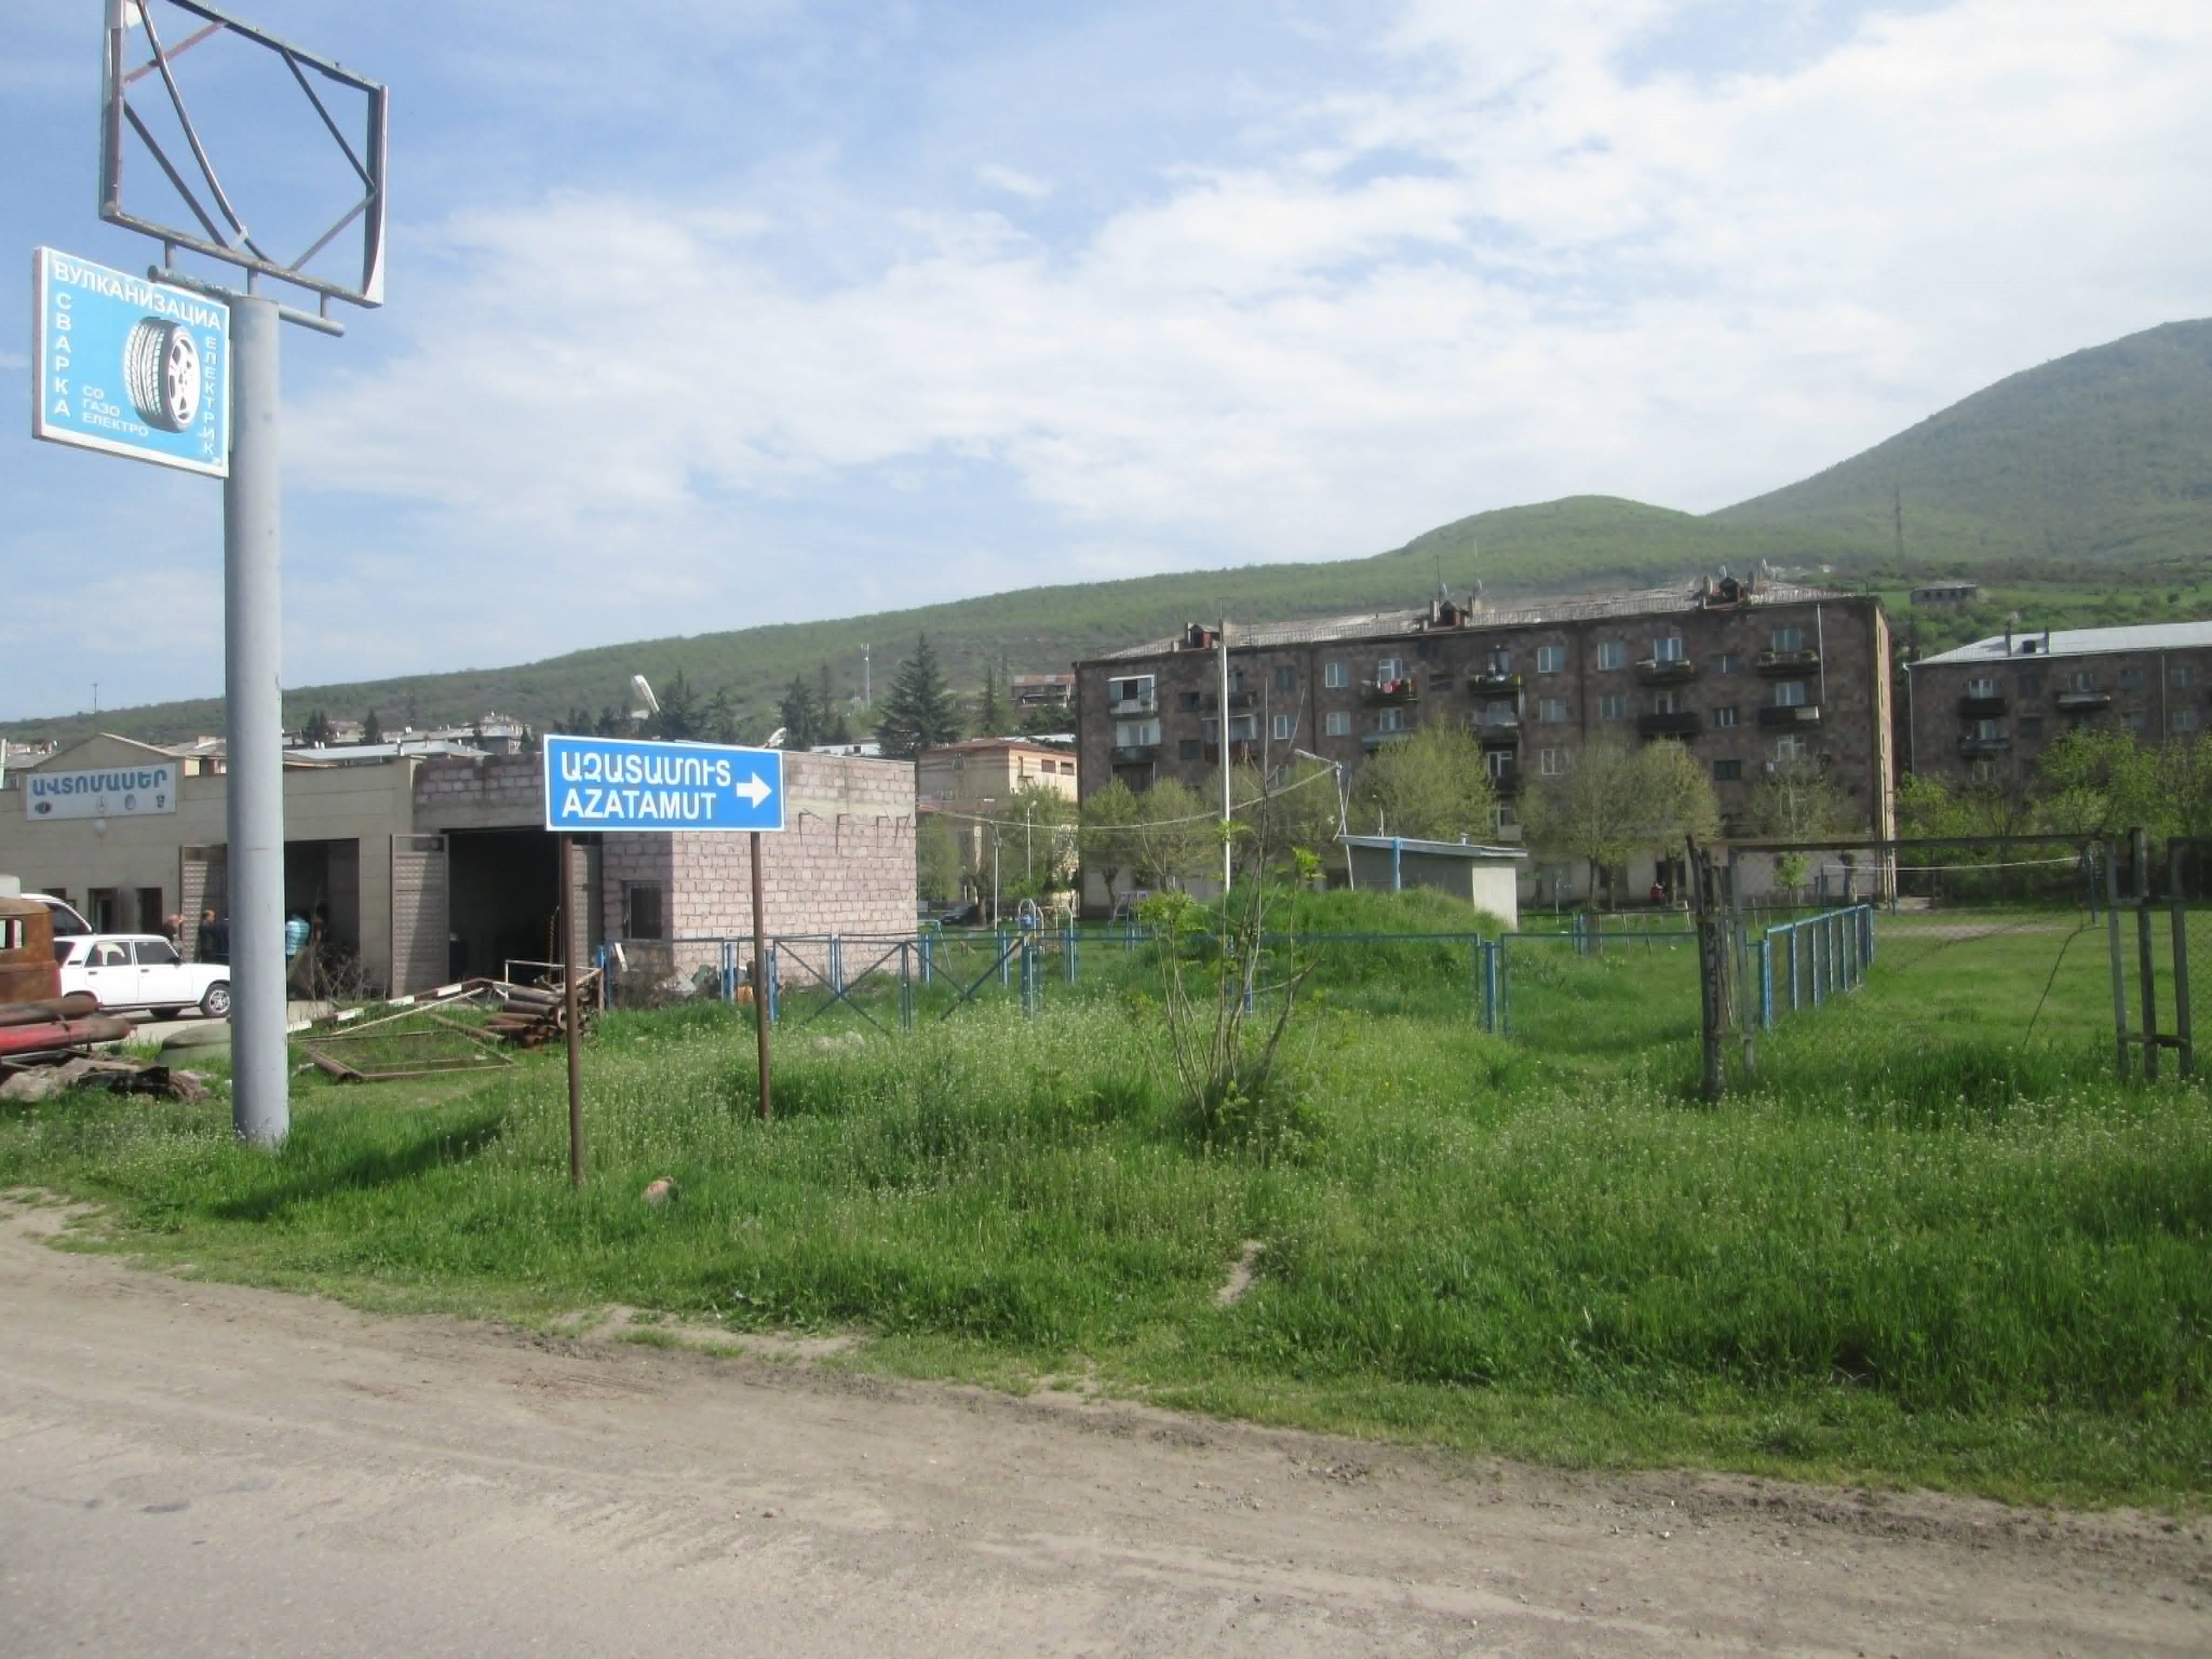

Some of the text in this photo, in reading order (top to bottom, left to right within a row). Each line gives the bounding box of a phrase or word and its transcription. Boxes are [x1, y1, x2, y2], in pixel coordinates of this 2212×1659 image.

[55, 261, 221, 331] ВУЛКАНИЗАЦИА
[55, 293, 72, 417] СВАРКА
[32, 769, 168, 797] ԱՎՏՈՄԱՍԵՐ
[561, 751, 731, 787] ԱԶԱՏԱՄՈՒՏ
[562, 787, 717, 819] AZATAMUT
